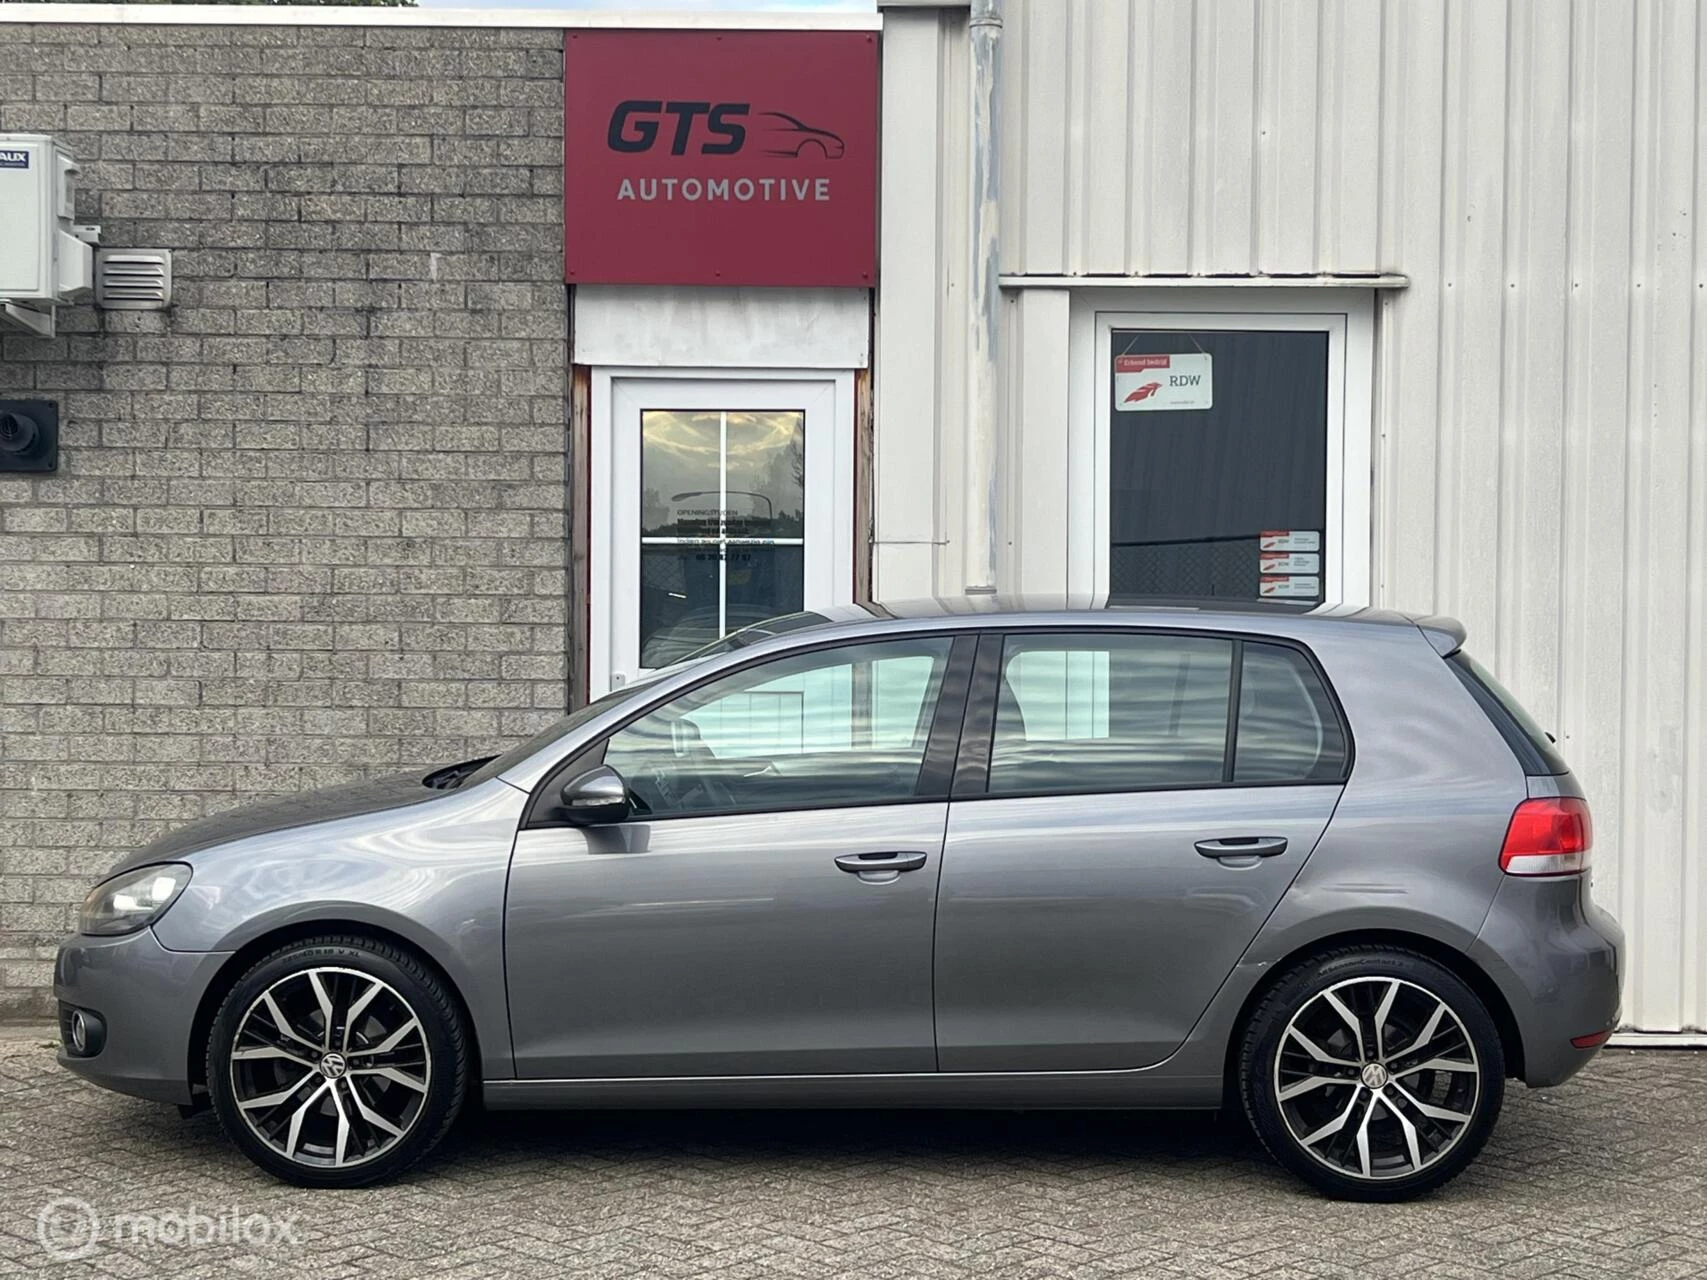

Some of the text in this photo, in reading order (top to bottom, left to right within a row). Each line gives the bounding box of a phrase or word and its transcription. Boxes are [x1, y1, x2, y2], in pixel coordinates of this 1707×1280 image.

[607, 100, 751, 156] GTS
[616, 178, 831, 201] AUTOMOTIVE
[1169, 375, 1202, 387] RDW
